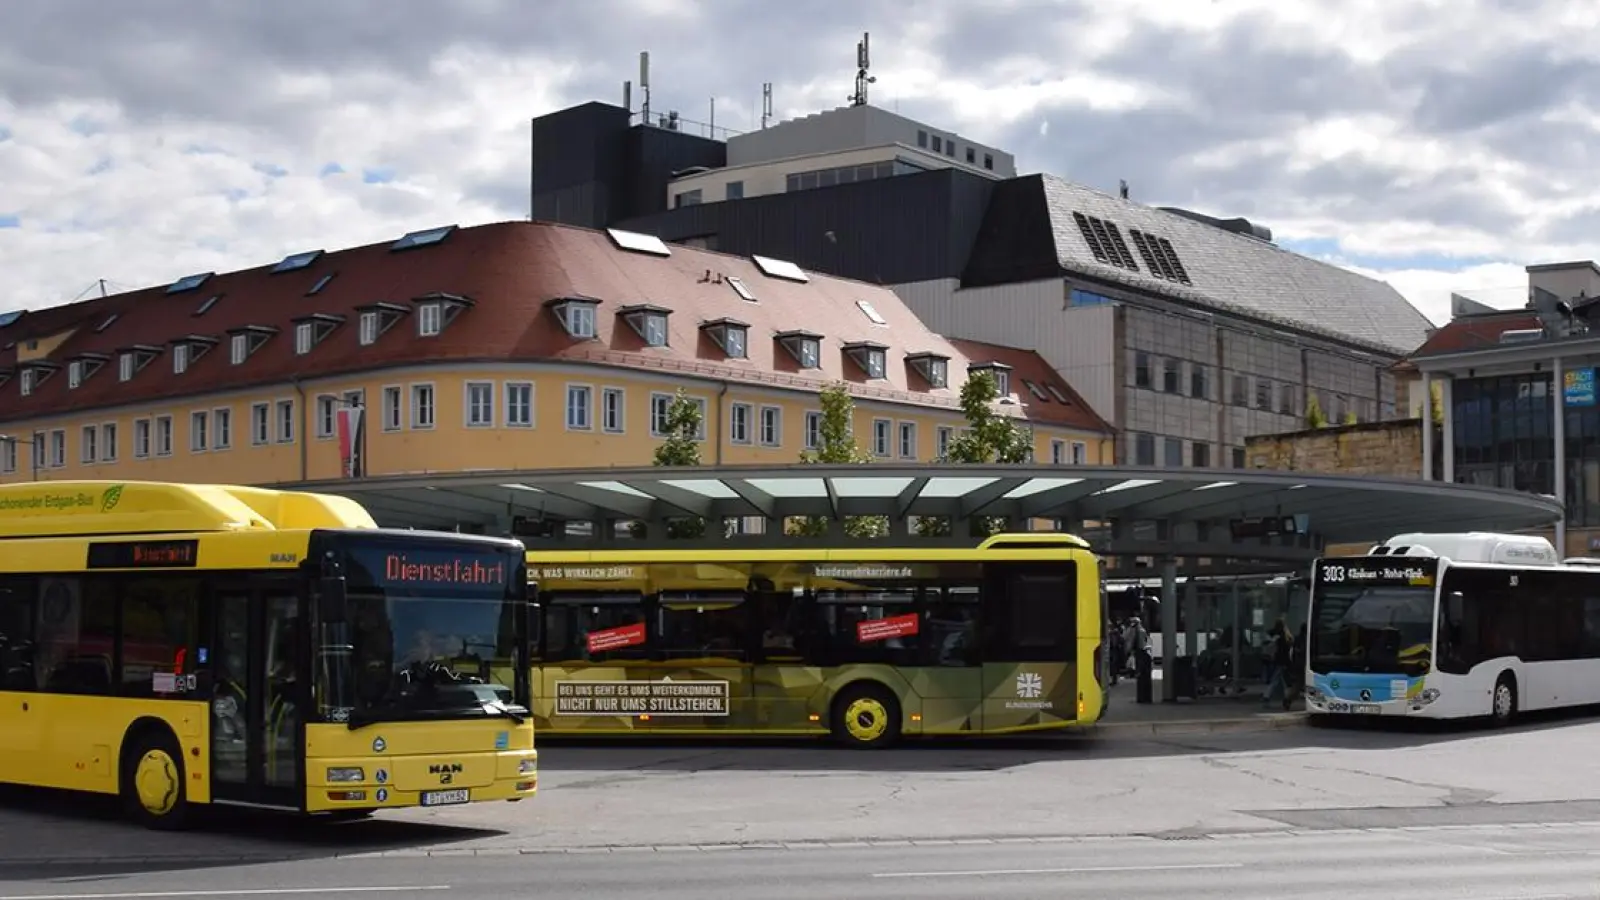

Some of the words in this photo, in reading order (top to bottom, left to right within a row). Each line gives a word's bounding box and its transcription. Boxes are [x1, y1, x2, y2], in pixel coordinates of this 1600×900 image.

[270, 553, 296, 563] MAN
[386, 554, 503, 584] Dienstfahrt
[543, 567, 562, 578] WAS
[564, 567, 605, 578] WIRKLICH
[815, 565, 912, 577] bundeswehrkarriere.de
[1323, 566, 1345, 582] 303
[559, 685, 574, 695] BEI
[576, 685, 592, 695] UNS
[594, 685, 615, 695] GEHT
[617, 685, 629, 695] ES
[631, 685, 650, 695] UMS
[652, 685, 723, 695] WEITERKOMMEN.
[559, 698, 592, 711] NICHT
[595, 698, 618, 711] NUR
[621, 698, 646, 711] UMS
[649, 698, 724, 711] STILLSTEHEN.
[429, 764, 462, 773] MAN
